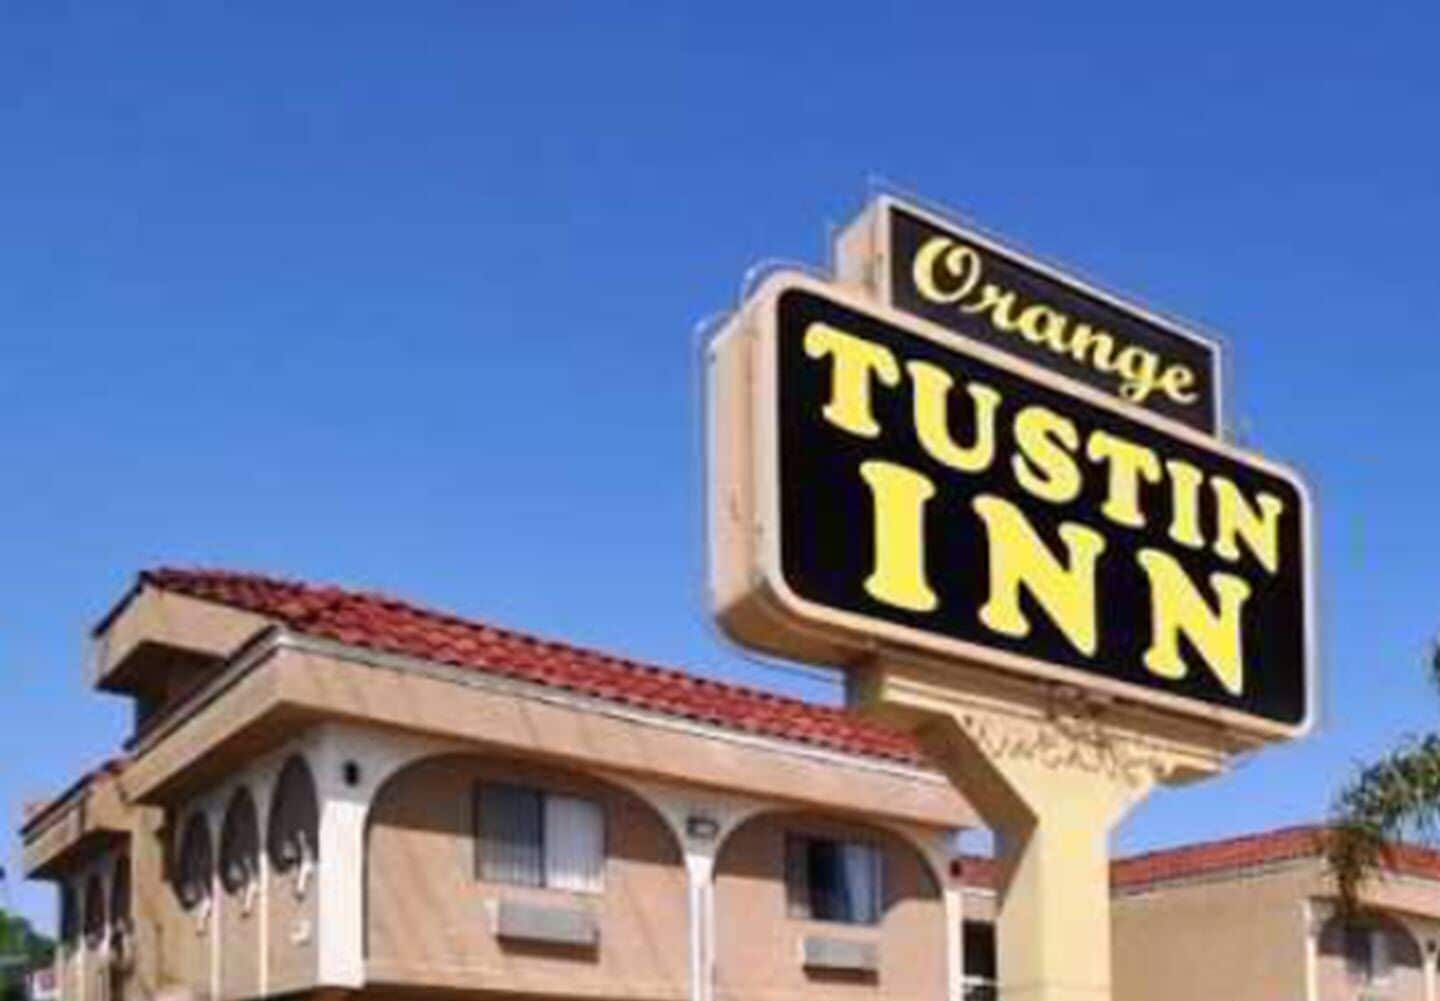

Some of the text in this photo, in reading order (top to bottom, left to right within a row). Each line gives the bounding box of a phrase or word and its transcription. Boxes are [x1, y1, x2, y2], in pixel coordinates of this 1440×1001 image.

[911, 234, 1198, 405] Orange
[803, 322, 1284, 574] TUSTIN
[858, 459, 1252, 694] INN
